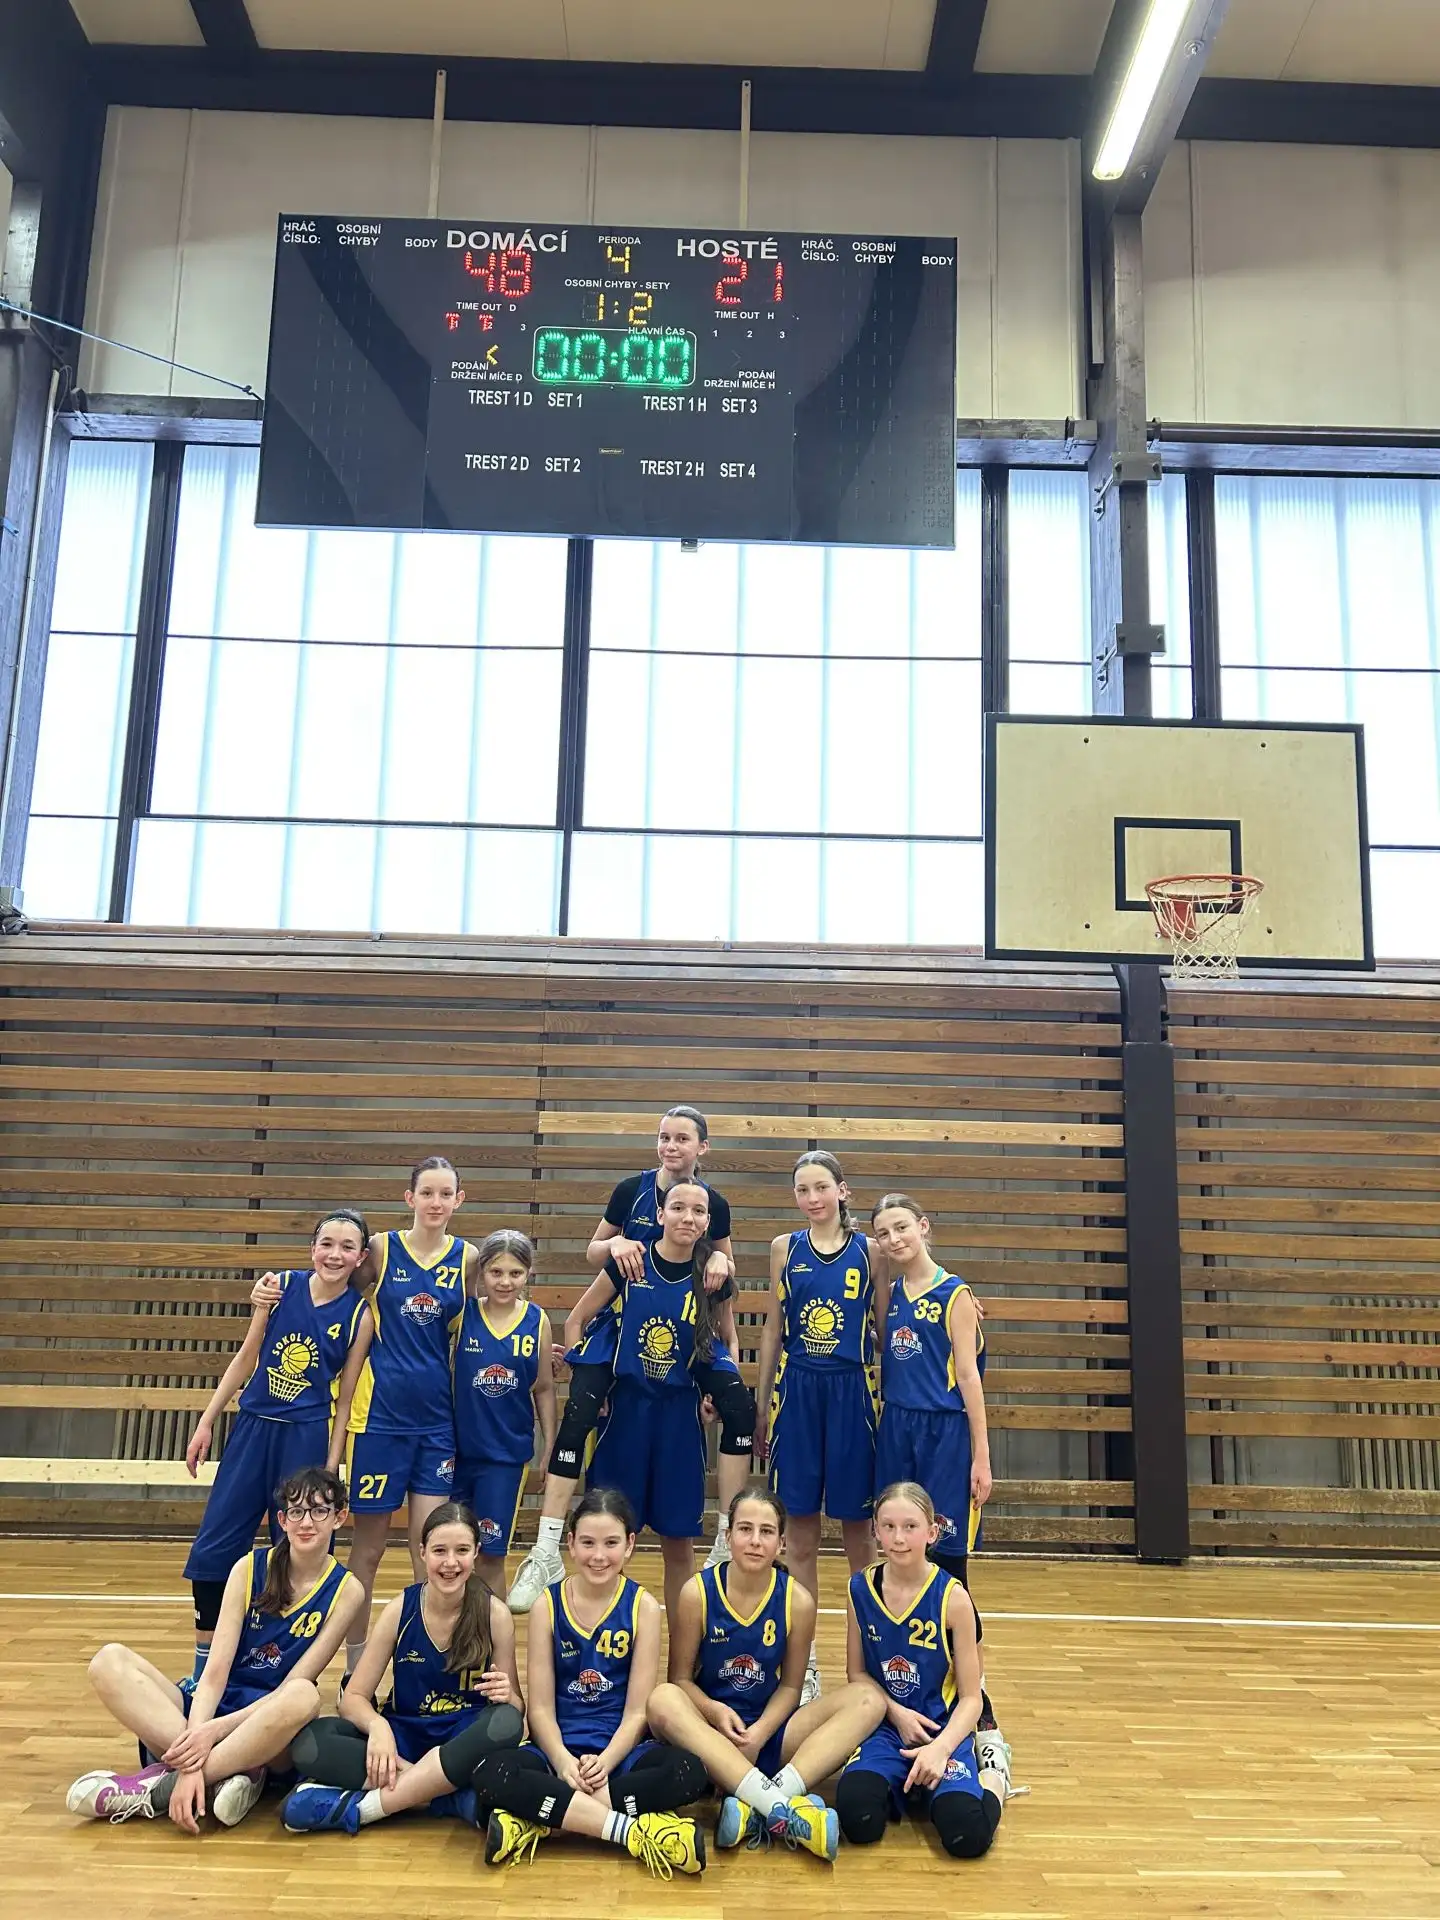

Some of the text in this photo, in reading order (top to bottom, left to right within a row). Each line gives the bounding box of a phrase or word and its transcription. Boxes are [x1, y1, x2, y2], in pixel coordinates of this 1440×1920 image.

[283, 221, 316, 232] HRÁČ
[336, 223, 381, 235] OSOBNÍ
[283, 232, 321, 244] ČÍSLO:
[338, 235, 379, 246] CHYBY
[405, 238, 438, 248] BODY
[446, 229, 569, 253] DOMÁCÍ
[598, 235, 641, 245] PERIODA
[801, 239, 834, 250] HRÁČ
[676, 237, 778, 260] HOSTÉ
[852, 242, 897, 253] OSOBNÍ
[606, 244, 631, 274] 4
[801, 250, 840, 262] ČÍSLO:
[854, 253, 895, 264] CHYBY
[921, 256, 954, 266] BODY
[463, 250, 533, 298] 48
[714, 256, 785, 304] 21
[564, 278, 602, 288] OSOBNÍ
[604, 280, 638, 290] CHYBY
[645, 281, 671, 290] SETY
[456, 302, 517, 312] TIME OUT D
[714, 310, 775, 320] TIME OUT H
[520, 323, 526, 331] 3
[628, 326, 686, 336] HLAVNÍ ČAS
[746, 330, 753, 338] 2
[779, 331, 785, 339] 3
[451, 361, 489, 370] PODÁNÍ
[536, 332, 690, 384] 00:00
[451, 371, 523, 381] DRŽENÍ MÍČE D
[738, 370, 776, 380] PODÁNÍ
[704, 378, 776, 389] DRŽENÍ MÍČE H
[469, 390, 511, 405] TREST
[547, 392, 583, 408] SET 1
[643, 396, 685, 411] TREST
[721, 398, 757, 414] SET 3
[464, 454, 508, 470] TREST
[545, 456, 581, 473] SET 2
[640, 460, 683, 476] TREST
[720, 462, 756, 478] SET 4
[435, 1265, 460, 1289] 27
[843, 1267, 861, 1300] 9
[800, 1297, 845, 1331] SOKOL NUSLE
[914, 1298, 943, 1324] 33
[326, 1322, 342, 1340] 4
[637, 1316, 663, 1343] SOKOL
[271, 1332, 320, 1369] SOKOL NUSLE
[511, 1334, 535, 1358] 16
[472, 1375, 517, 1387] SOKOL NUSLE
[358, 1474, 388, 1499] 27
[289, 1611, 322, 1638] 48
[762, 1619, 777, 1646] 8
[908, 1618, 938, 1650] 22
[595, 1629, 630, 1659] 43
[719, 1666, 744, 1678] SOKOL
